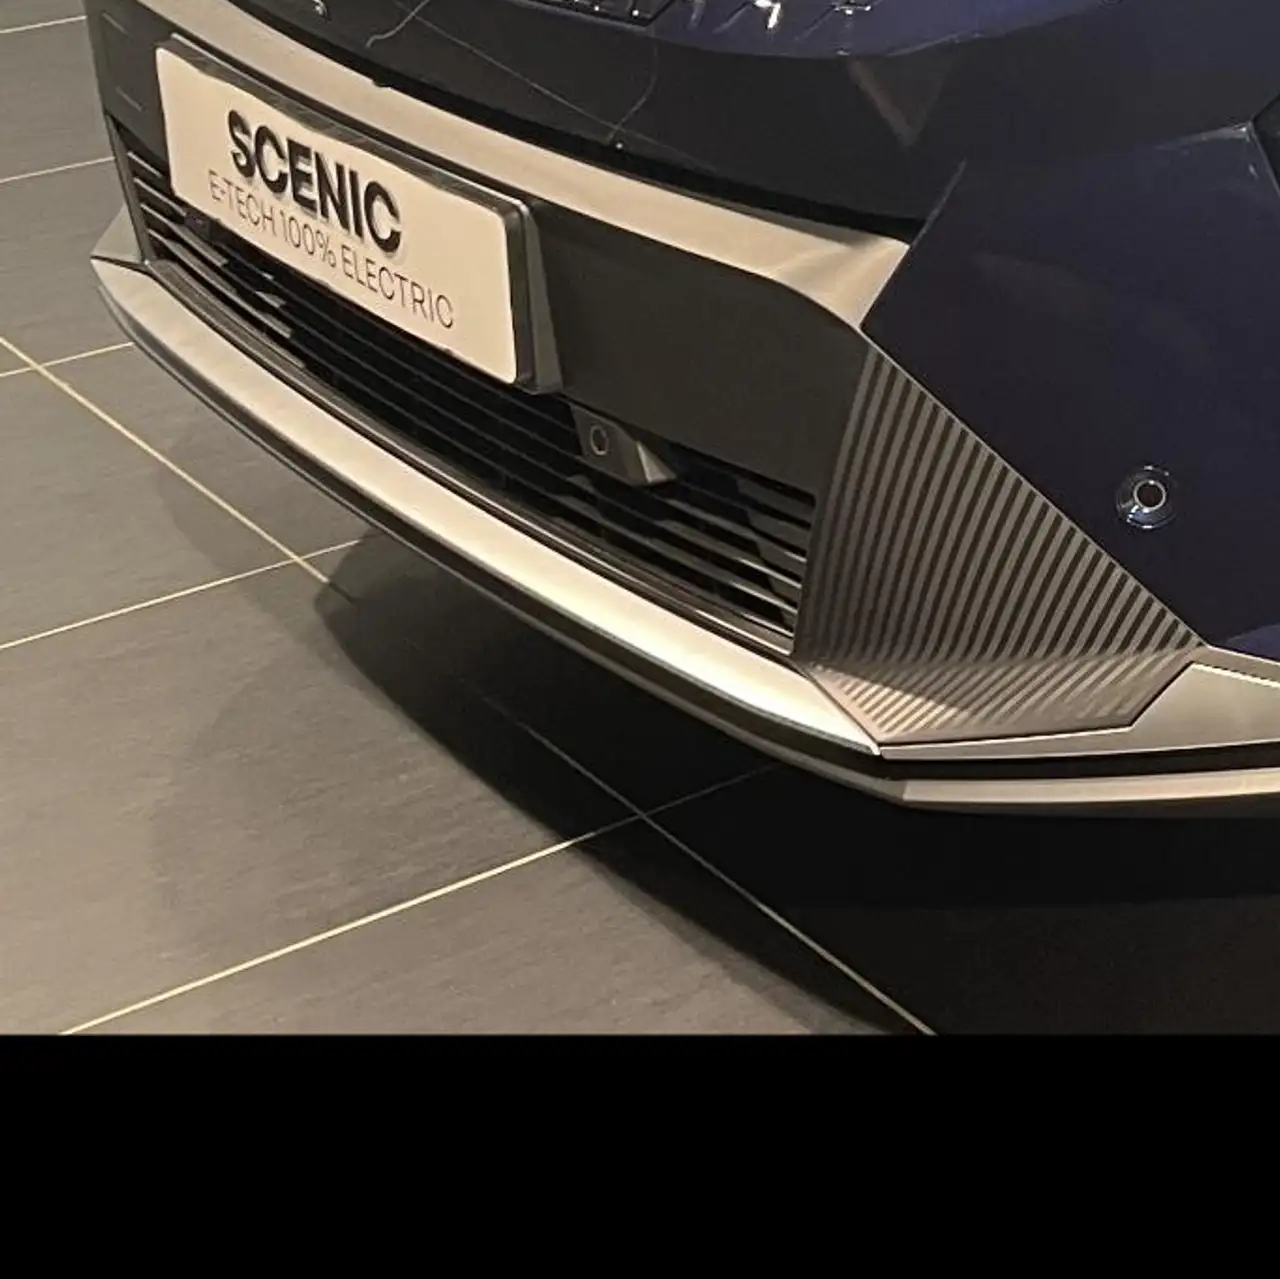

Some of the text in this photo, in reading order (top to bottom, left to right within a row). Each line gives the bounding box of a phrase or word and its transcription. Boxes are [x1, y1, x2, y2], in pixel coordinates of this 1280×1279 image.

[208, 170, 455, 329] E-TECH 100% ELECTRIC
[227, 109, 402, 253] SCENIC
